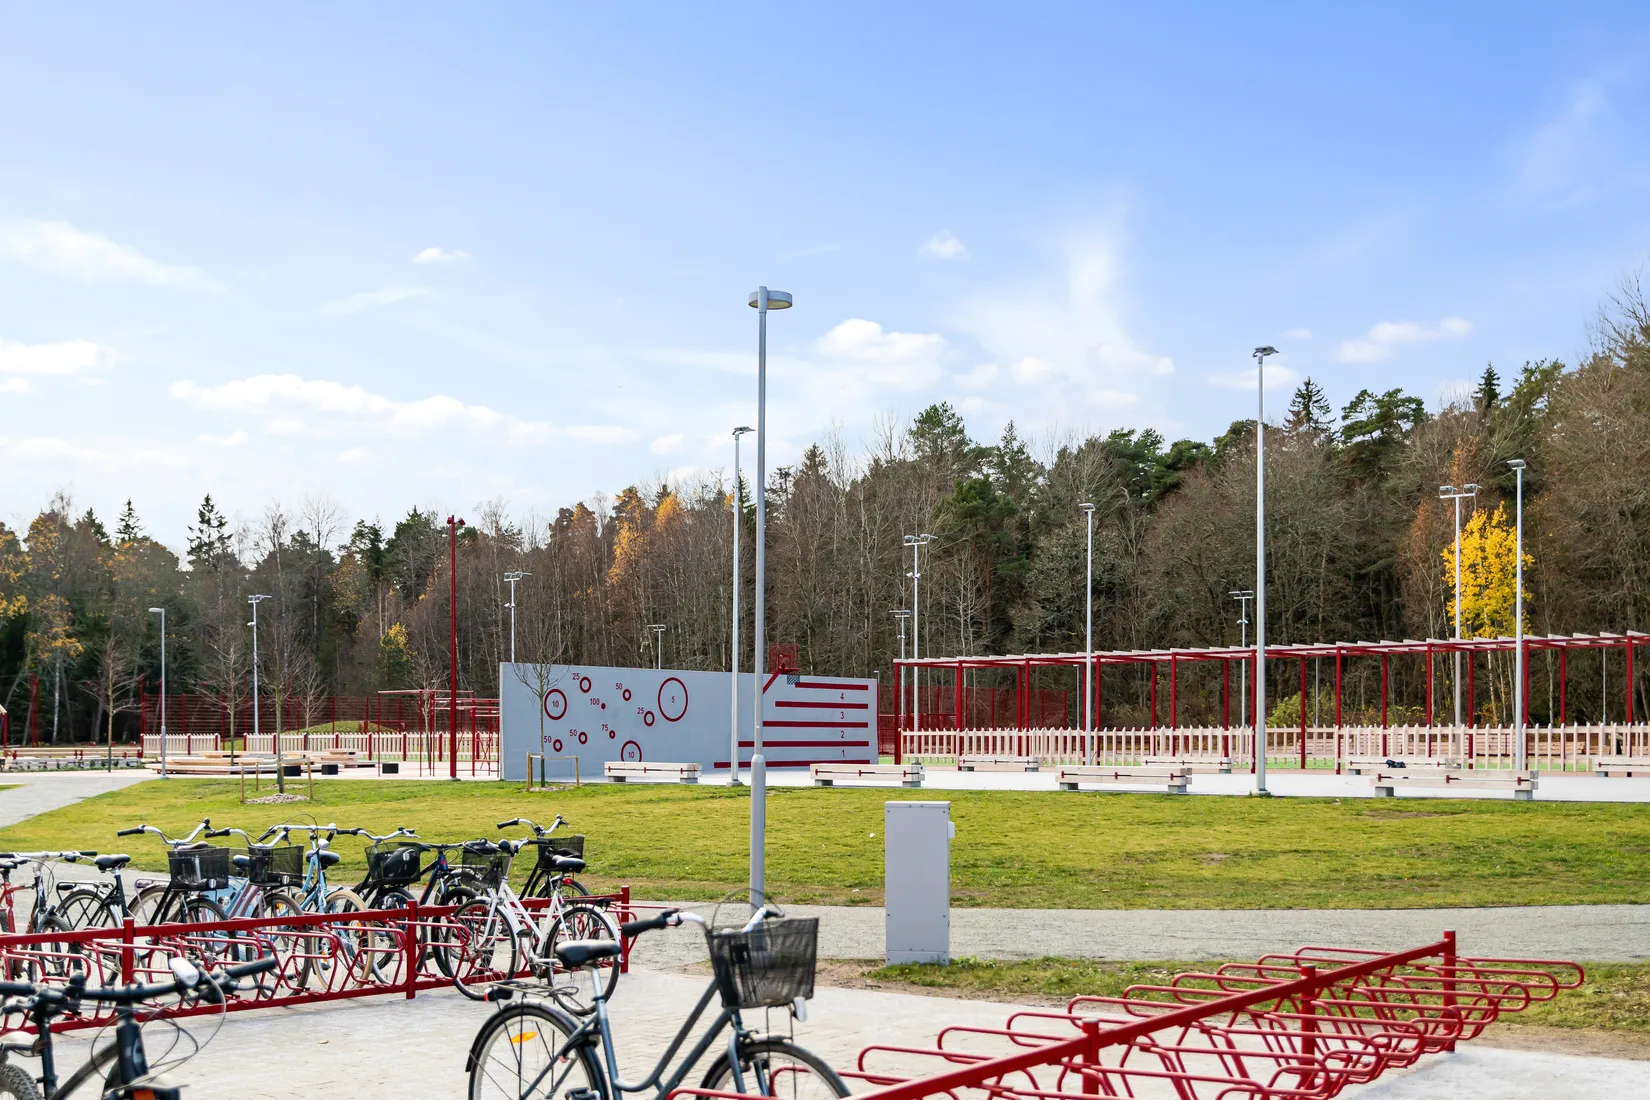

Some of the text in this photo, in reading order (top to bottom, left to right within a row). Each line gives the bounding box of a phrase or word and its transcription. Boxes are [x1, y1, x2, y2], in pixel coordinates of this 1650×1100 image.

[840, 692, 844, 700] 4
[589, 698, 600, 706] 100
[840, 710, 844, 720] 3
[840, 730, 845, 738] 2
[544, 736, 552, 744] 50
[628, 751, 635, 759] 10
[841, 749, 846, 758] 1
